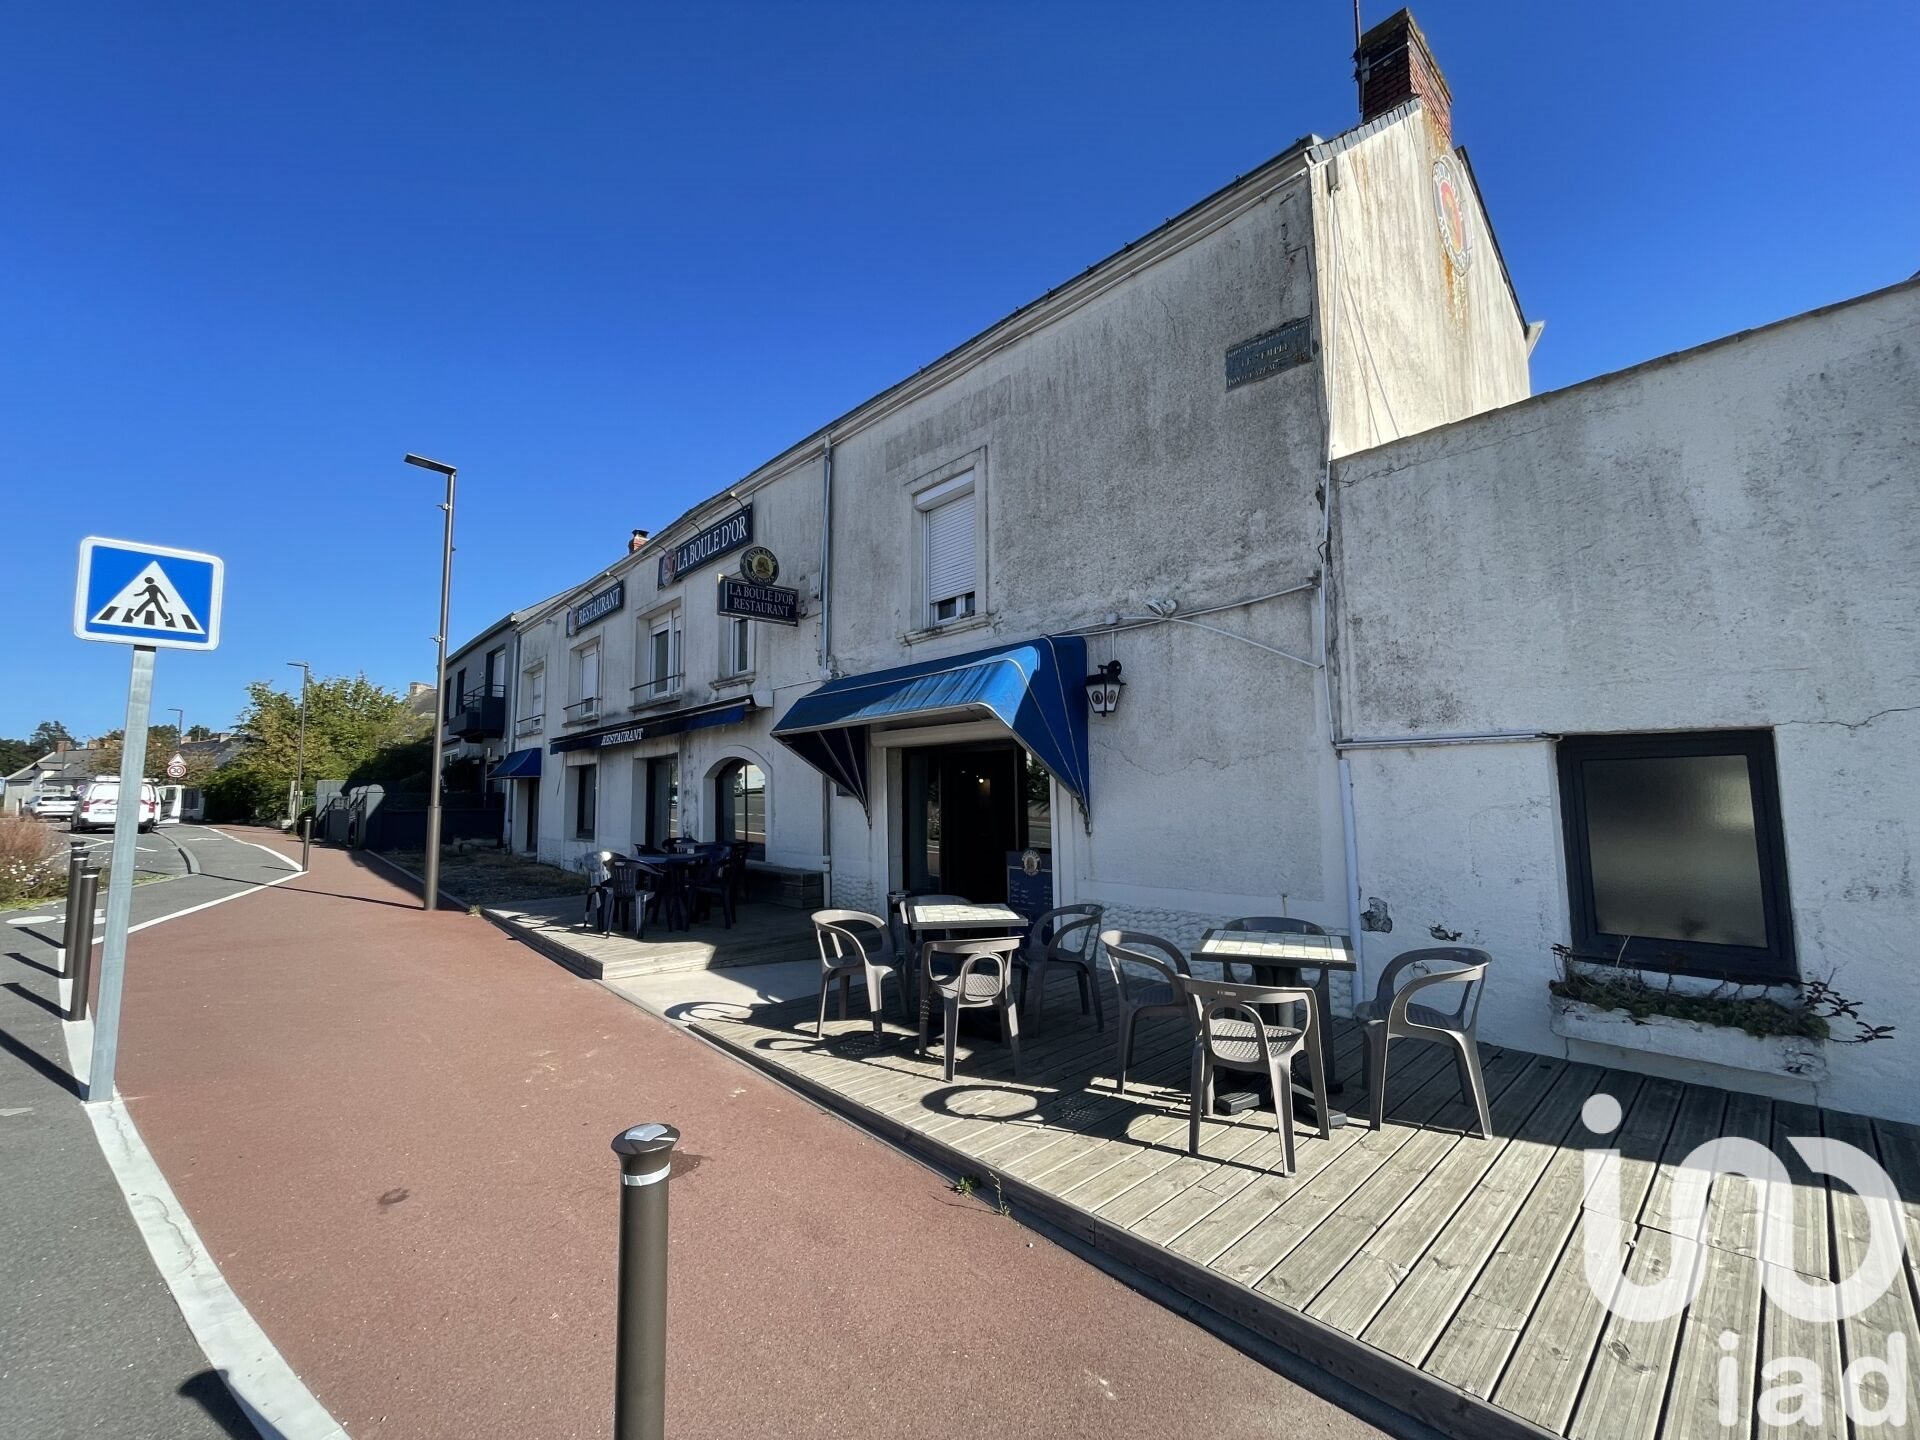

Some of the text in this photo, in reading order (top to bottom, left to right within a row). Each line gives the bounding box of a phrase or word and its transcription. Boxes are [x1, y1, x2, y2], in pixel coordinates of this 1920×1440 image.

[677, 515, 747, 572] LA BOULE D'OR
[729, 583, 795, 606] LA BOULE D'OR
[578, 587, 621, 626] RESTAURANT
[733, 598, 790, 618] RESTAURANT
[600, 727, 644, 746] RESTAURANT
